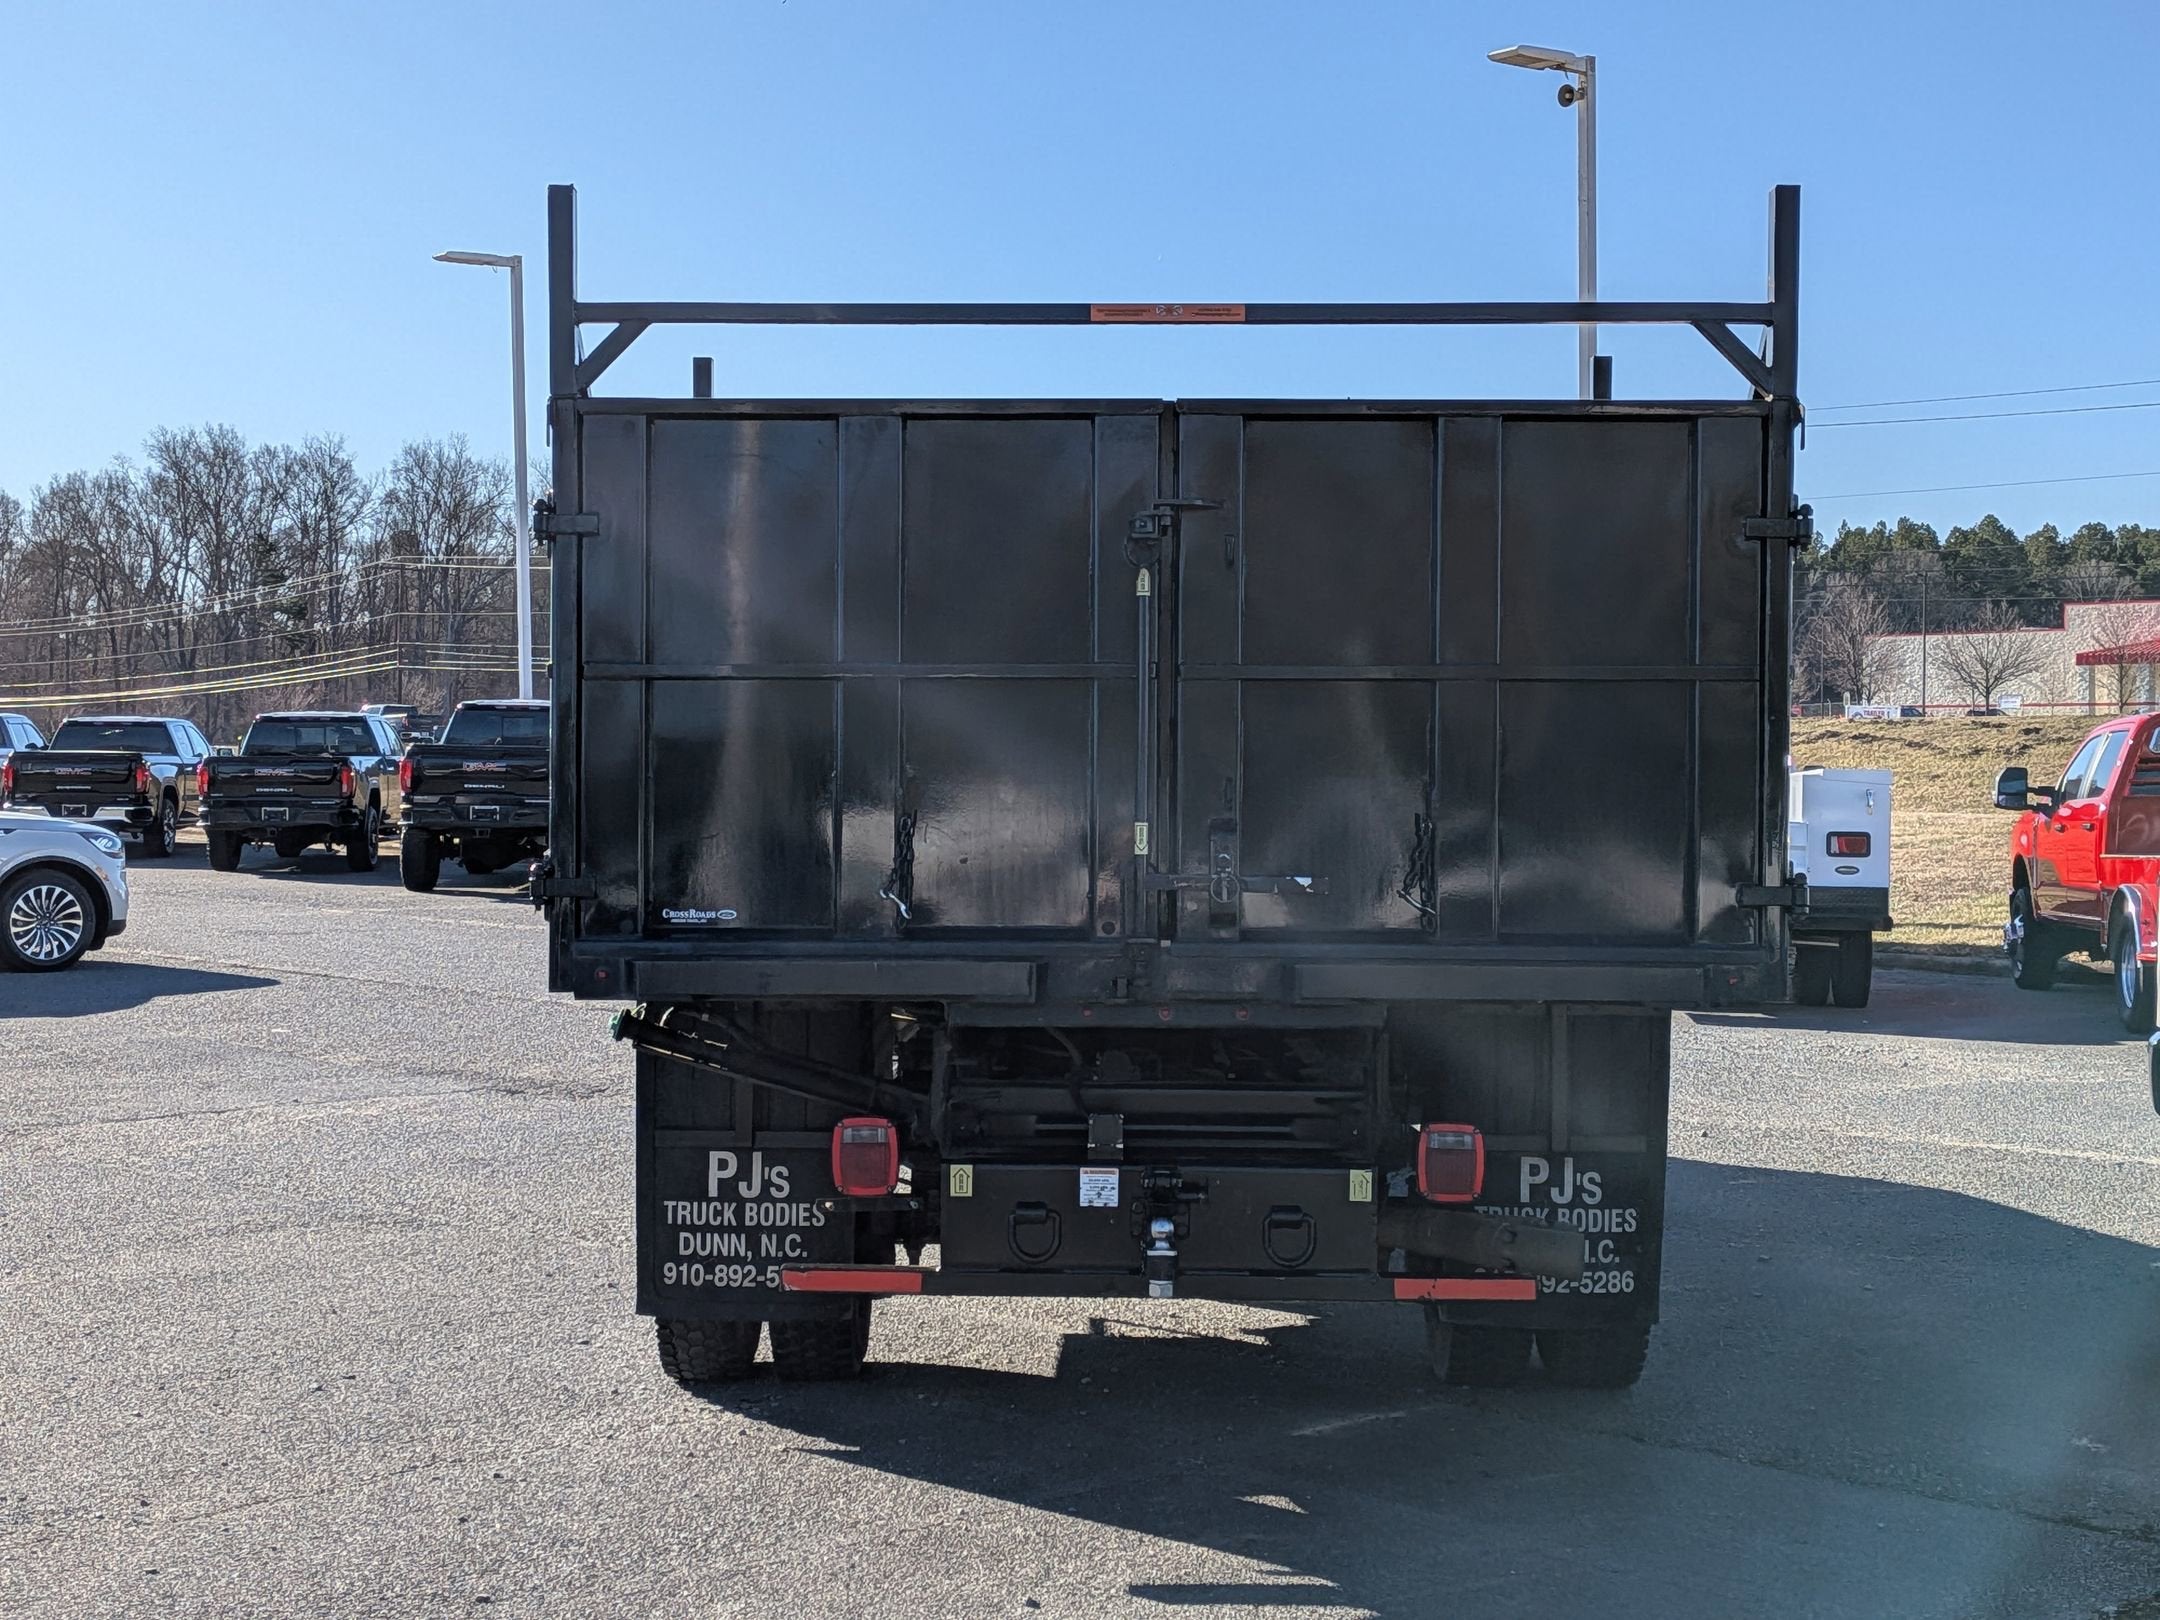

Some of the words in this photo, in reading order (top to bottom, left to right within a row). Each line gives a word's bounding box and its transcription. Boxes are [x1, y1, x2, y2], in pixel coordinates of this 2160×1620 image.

[663, 1201, 737, 1226] TRUCK
[744, 1202, 826, 1227] BODIES
[1557, 1207, 1637, 1233] BODIES
[679, 1231, 754, 1261] DUNN,
[760, 1233, 808, 1258] N.C.
[663, 1262, 780, 1288] 910-892-5
